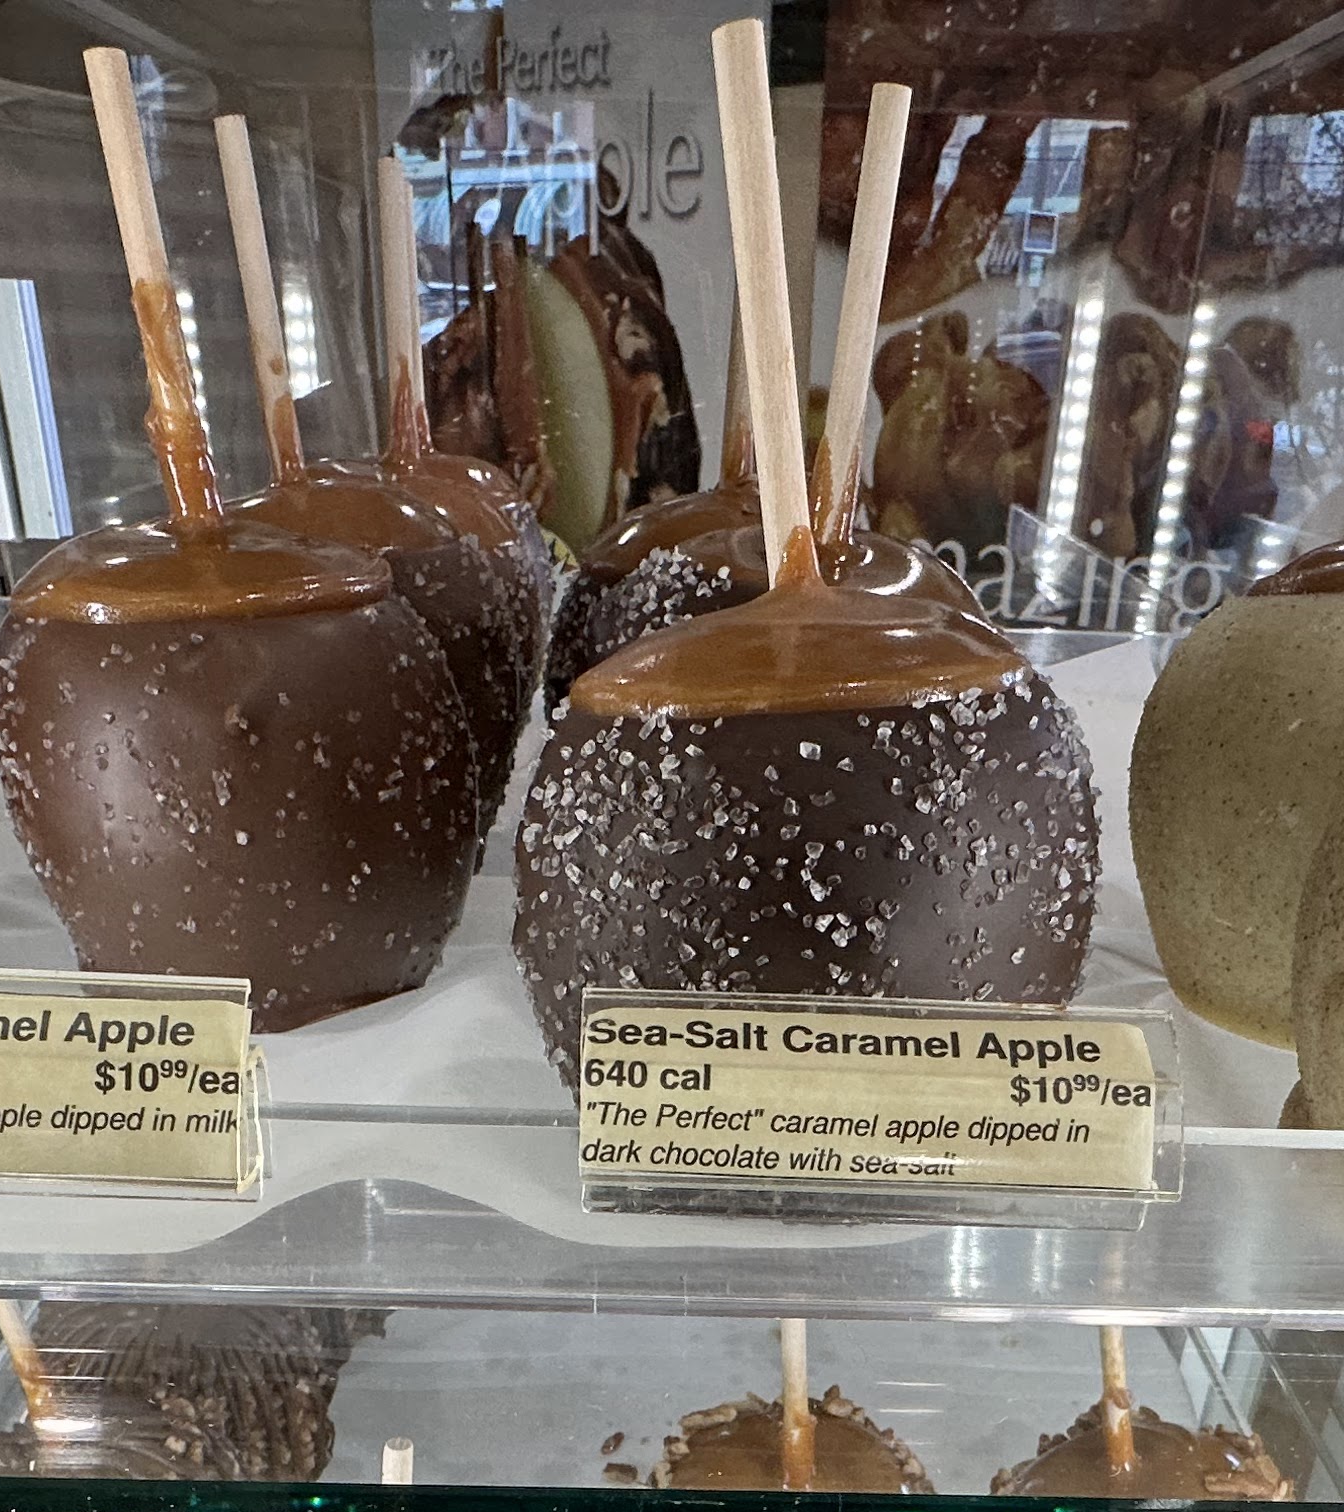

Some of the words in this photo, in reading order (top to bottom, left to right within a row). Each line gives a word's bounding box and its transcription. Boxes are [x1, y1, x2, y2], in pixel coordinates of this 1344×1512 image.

[497, 26, 611, 93] Perfect
[64, 1011, 195, 1053] Apple
[587, 1018, 768, 1051] Sea-Salt
[782, 1025, 960, 1058] Caramel
[976, 1032, 1101, 1068] Apple
[584, 1058, 648, 1088] 640
[659, 1064, 711, 1091] cal
[1010, 1074, 1152, 1107] $1099/ea
[51, 1105, 145, 1135] dipped
[152, 1107, 176, 1131] in
[185, 1109, 238, 1134] milk
[586, 1101, 648, 1127] "The
[655, 1103, 765, 1132] Perfect"
[770, 1113, 879, 1137] caramel
[885, 1115, 959, 1144] apple
[967, 1116, 1061, 1146] dipped
[1066, 1119, 1090, 1143] in
[581, 1138, 643, 1164] dark
[649, 1140, 779, 1169] chocolate
[789, 1147, 841, 1172] with
